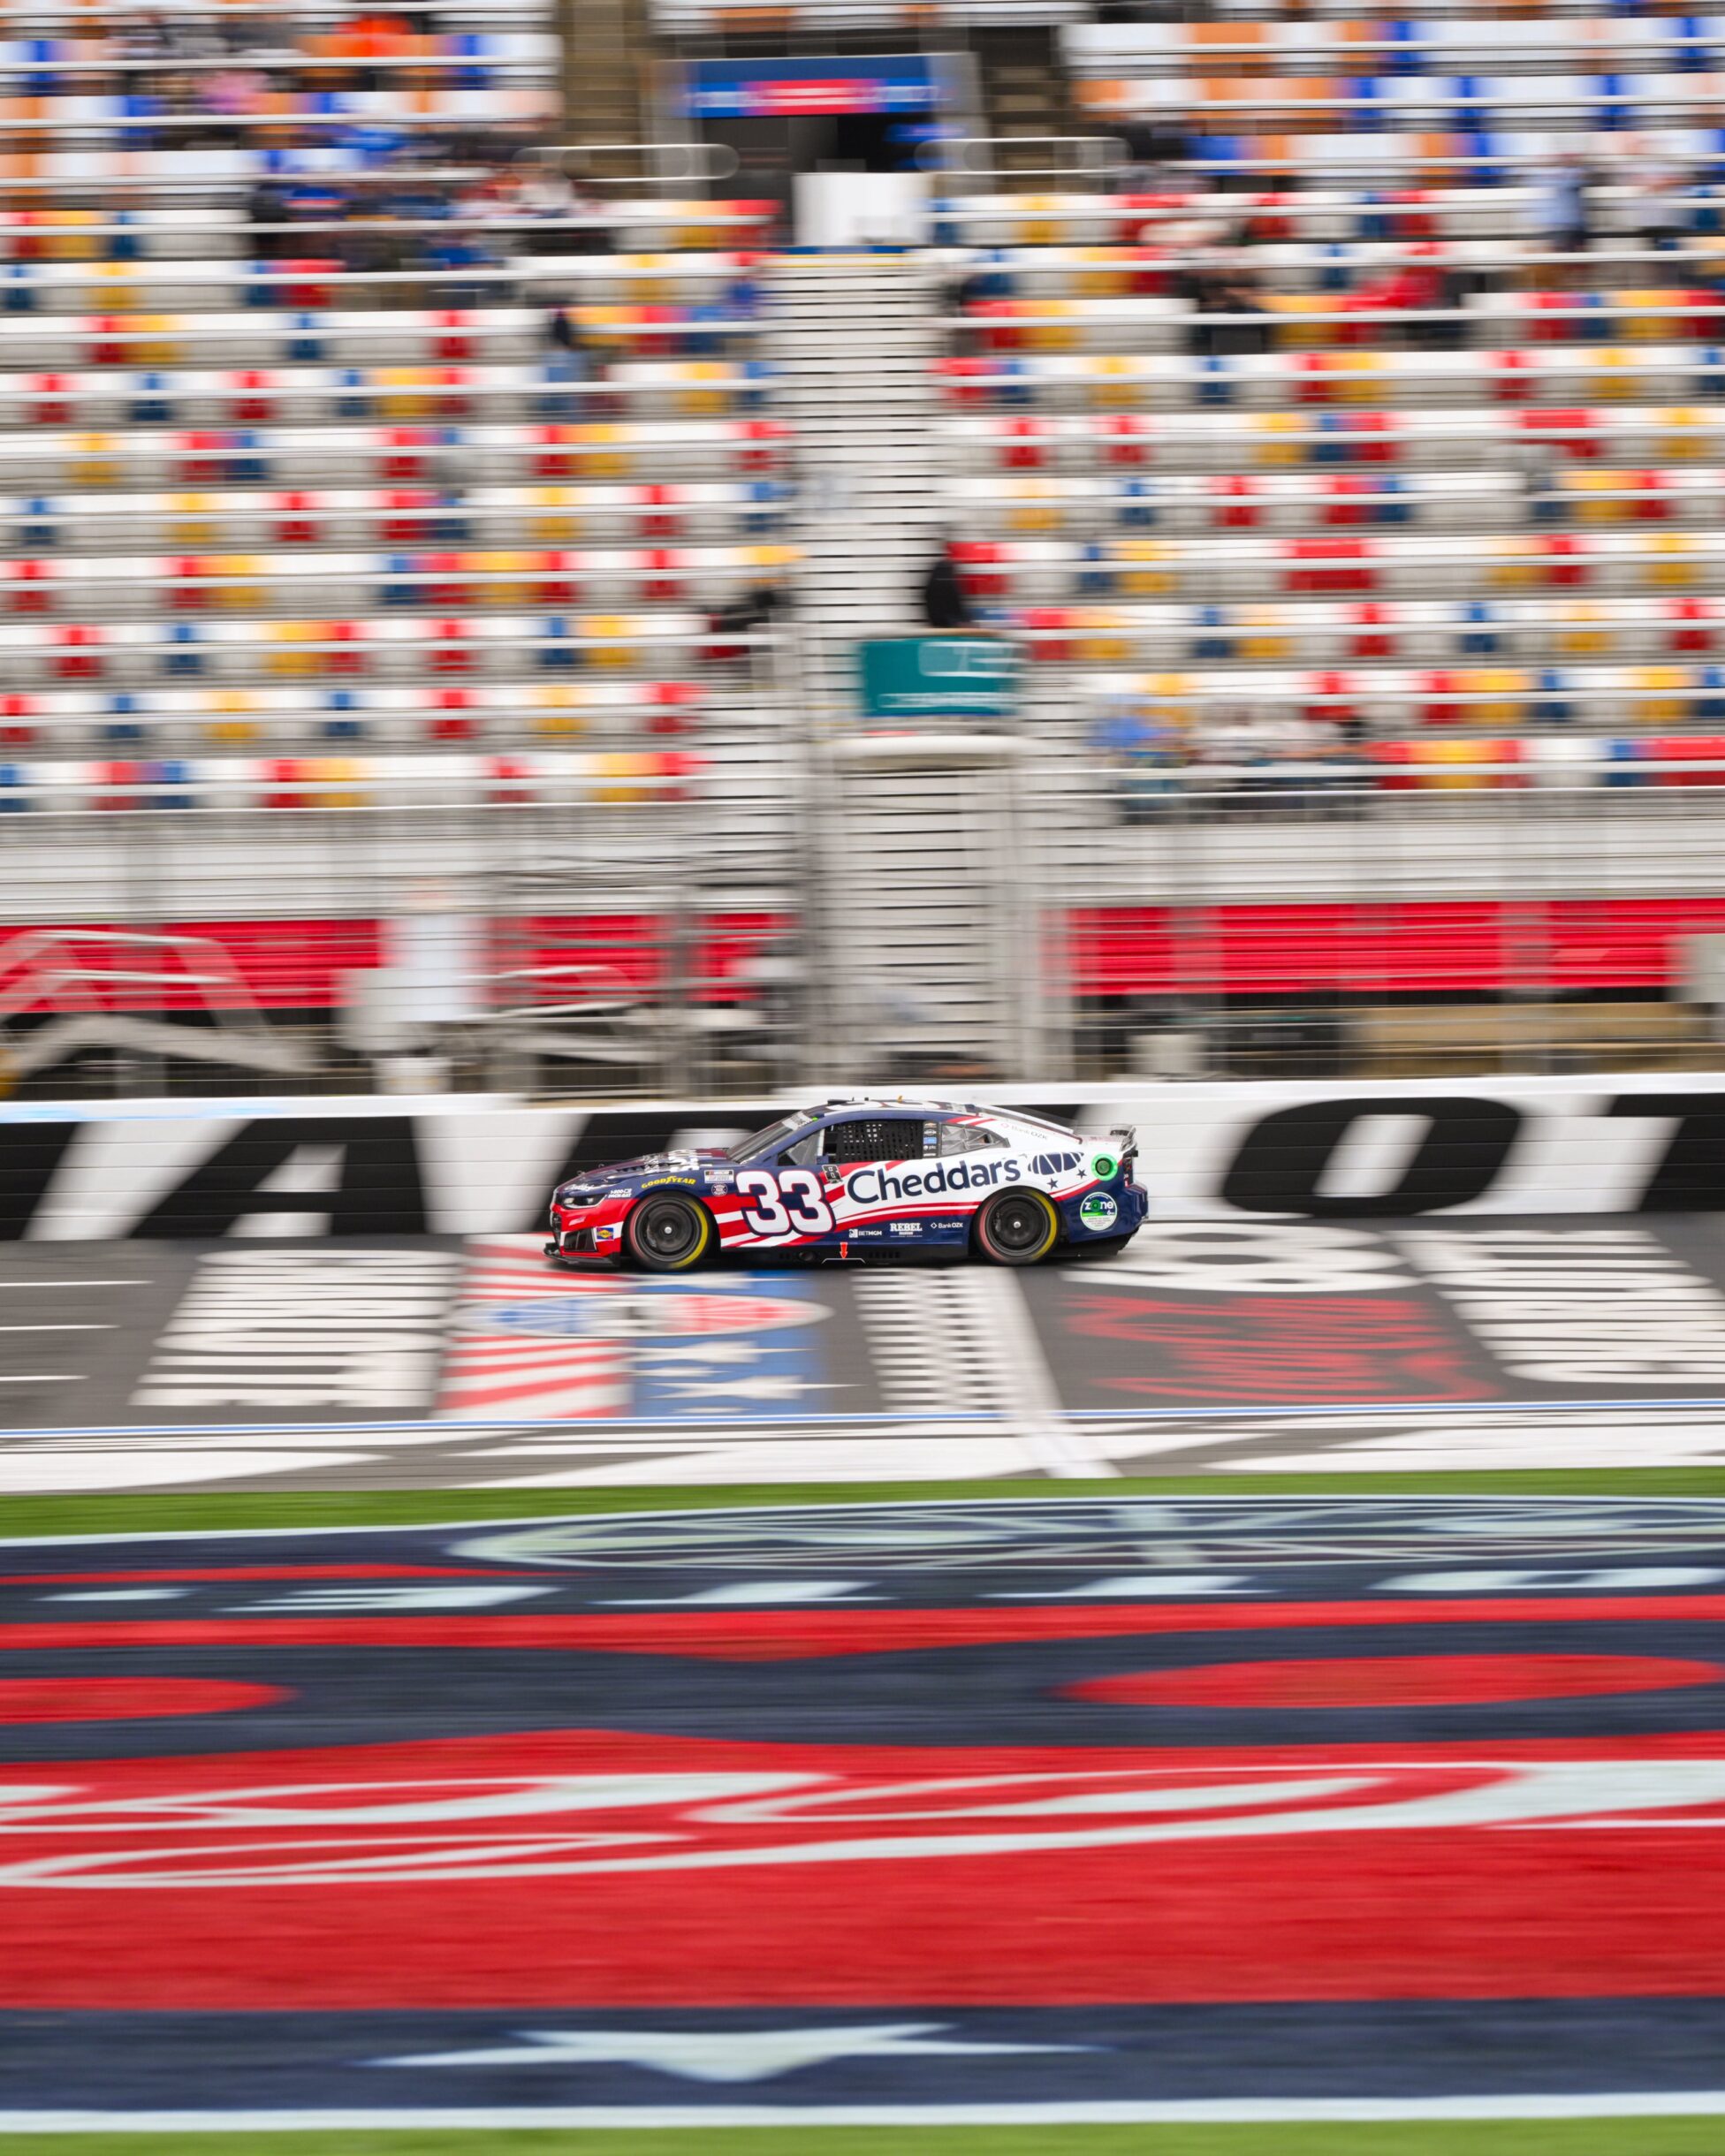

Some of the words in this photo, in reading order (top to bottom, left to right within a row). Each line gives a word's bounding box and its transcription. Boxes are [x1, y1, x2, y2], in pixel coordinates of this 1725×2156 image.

[641, 1175, 696, 1188] GOODYEAR
[735, 1170, 834, 1234] 33
[890, 1222, 923, 1232] REBEL
